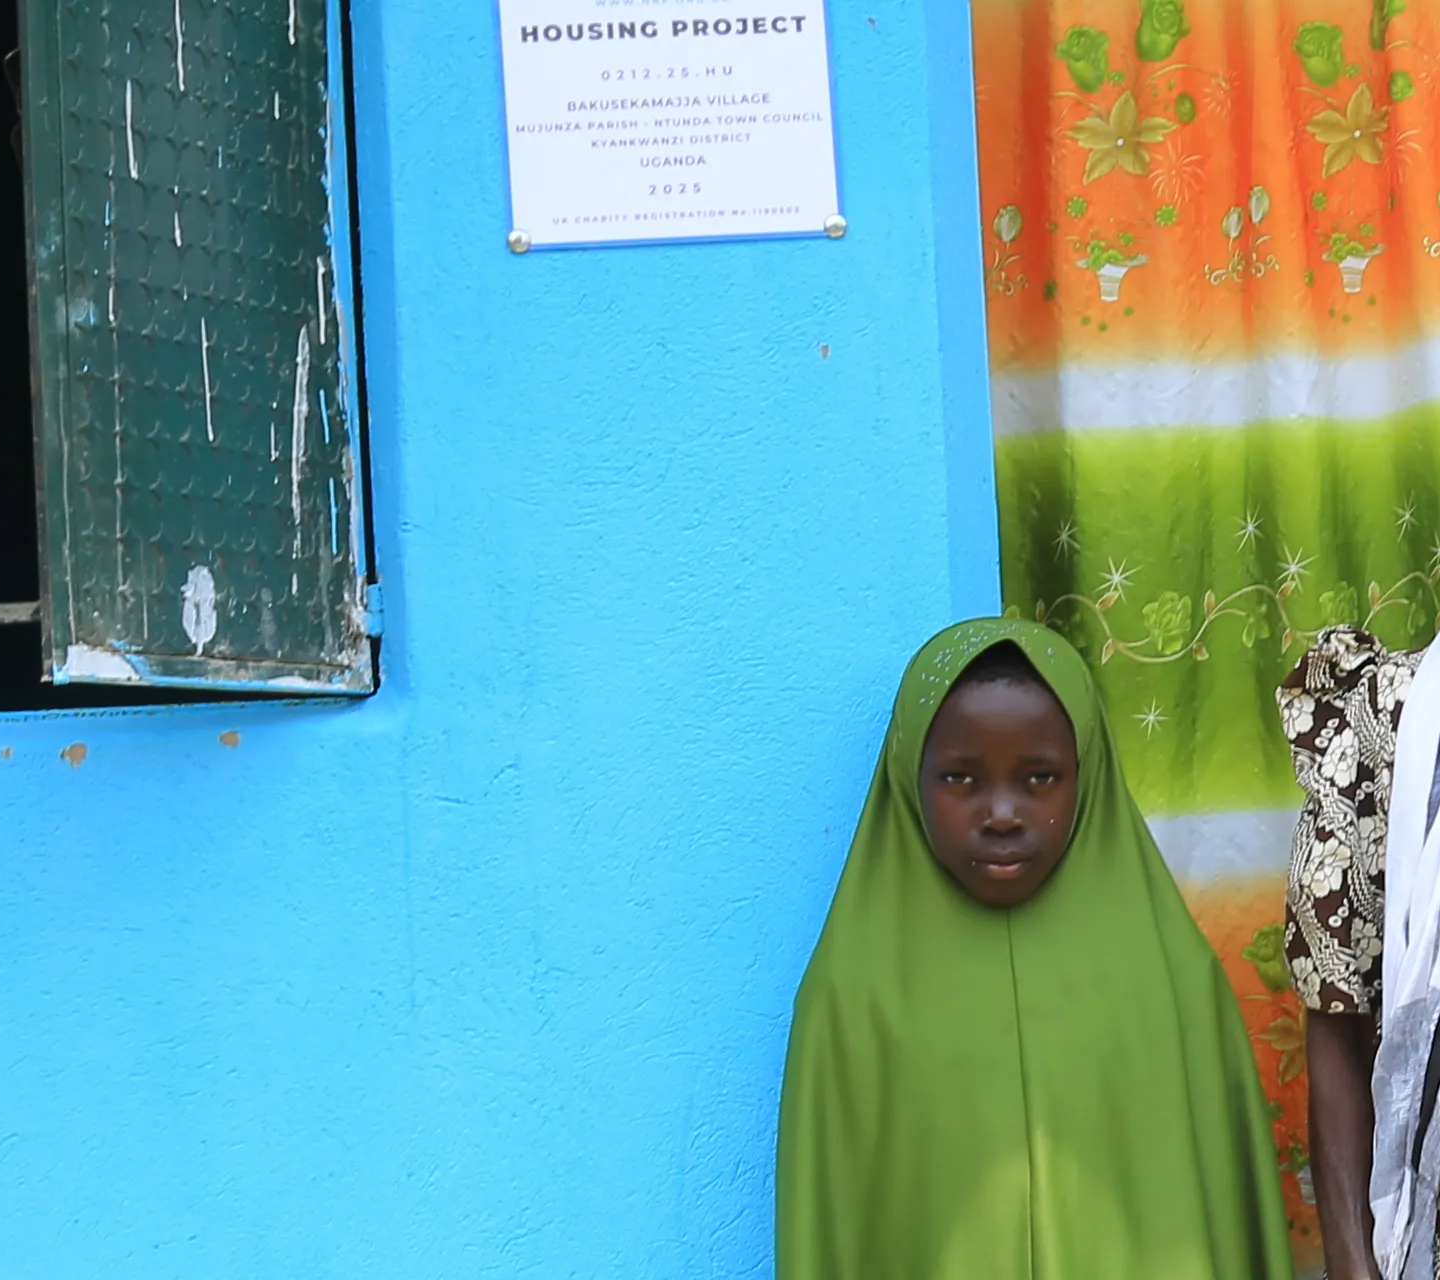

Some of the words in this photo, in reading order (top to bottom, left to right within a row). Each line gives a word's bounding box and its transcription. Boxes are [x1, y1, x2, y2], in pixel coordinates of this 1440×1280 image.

[520, 21, 659, 43] HOUSING
[671, 16, 807, 37] PROJECT
[706, 93, 771, 106] VILLAGE
[587, 120, 639, 130] PARISH
[716, 115, 757, 125] TOWN
[762, 112, 823, 123] COUNCIL
[689, 133, 751, 145] DISTRICT
[639, 155, 707, 168] UGANDA
[648, 183, 702, 195] 2025
[574, 214, 628, 224] CHARITY
[633, 210, 726, 221] REGISTRATION
